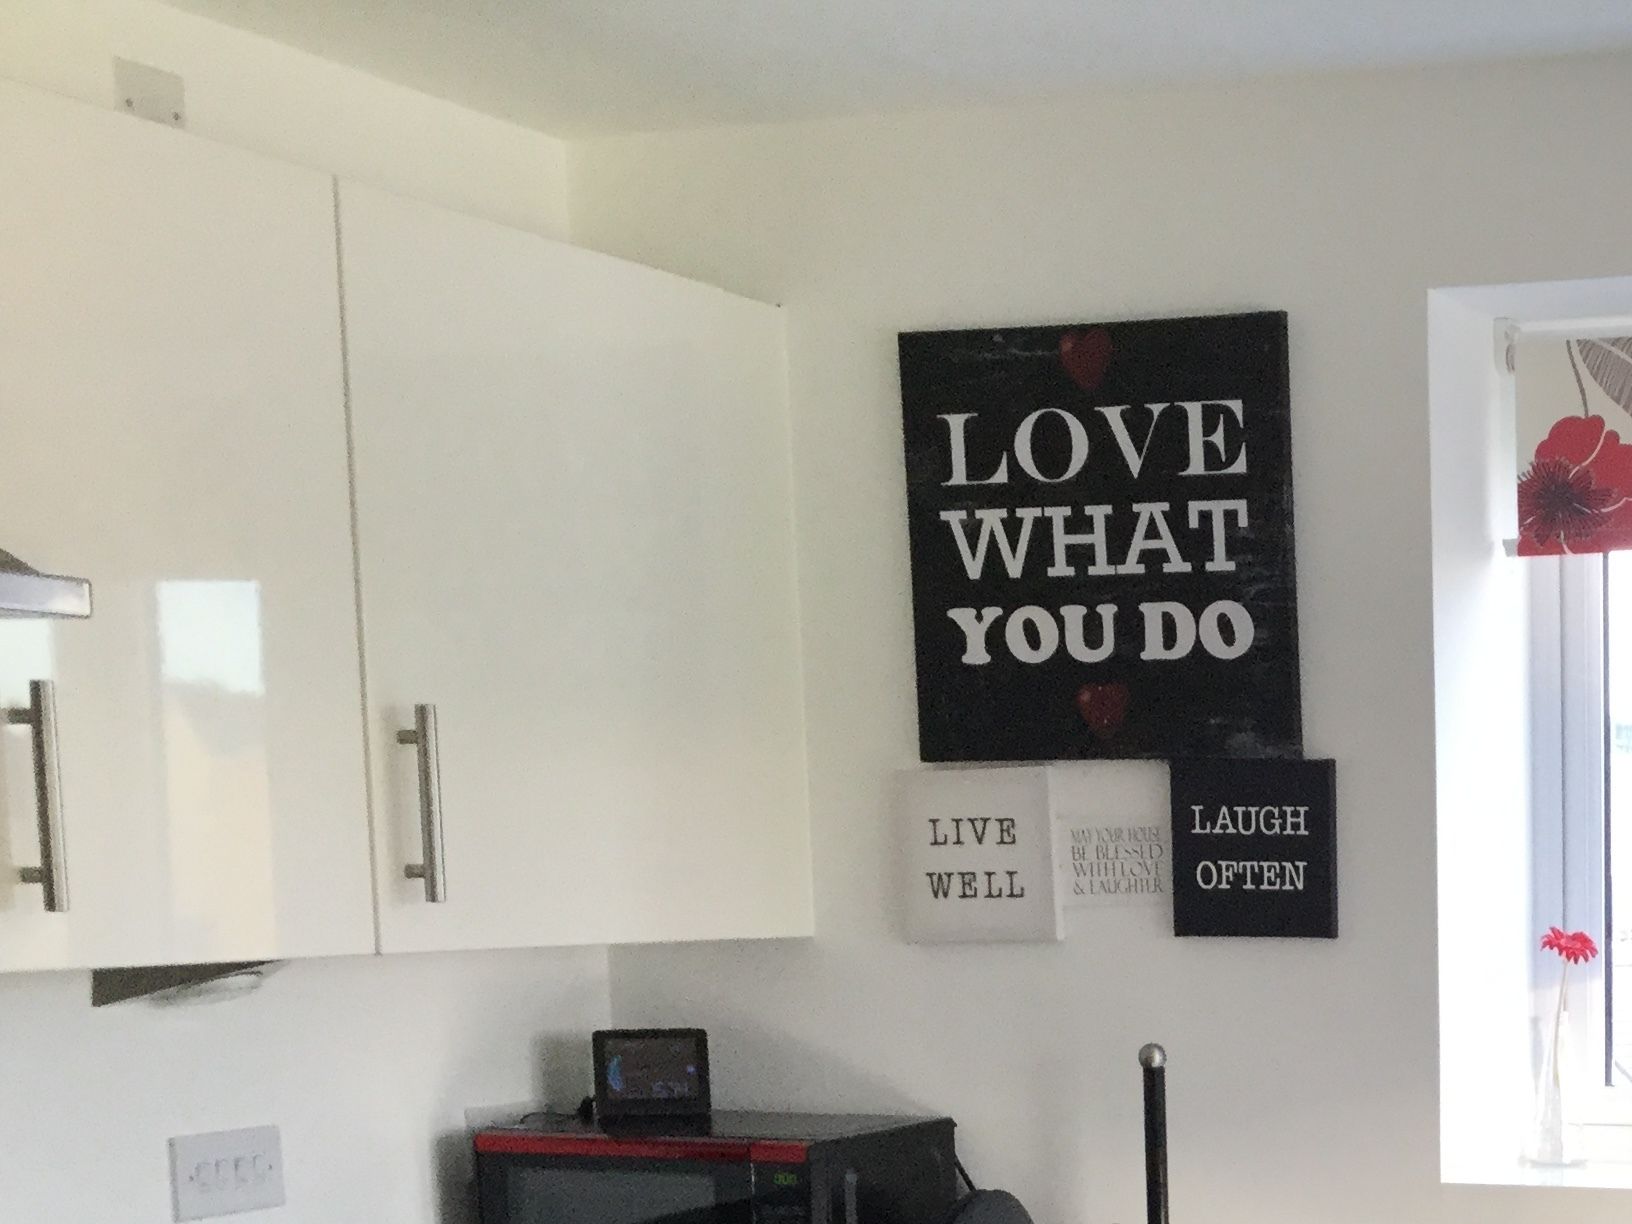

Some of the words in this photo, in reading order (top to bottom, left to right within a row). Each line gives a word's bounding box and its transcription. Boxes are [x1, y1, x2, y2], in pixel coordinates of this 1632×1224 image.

[936, 399, 1248, 487] LOVE
[939, 499, 1249, 581] WHAT
[946, 603, 1119, 665] YOU
[1139, 599, 1255, 662] DO
[928, 817, 1017, 847] LIVE
[1190, 805, 1310, 836] LAUGH
[1071, 844, 1086, 861] BE
[1072, 861, 1116, 878] WITH
[1119, 860, 1162, 878] LOVE
[1196, 860, 1308, 890] OFTEN
[926, 871, 1025, 900] WELL
[1073, 880, 1086, 896] &
[1089, 877, 1164, 895] LAUGHTER
